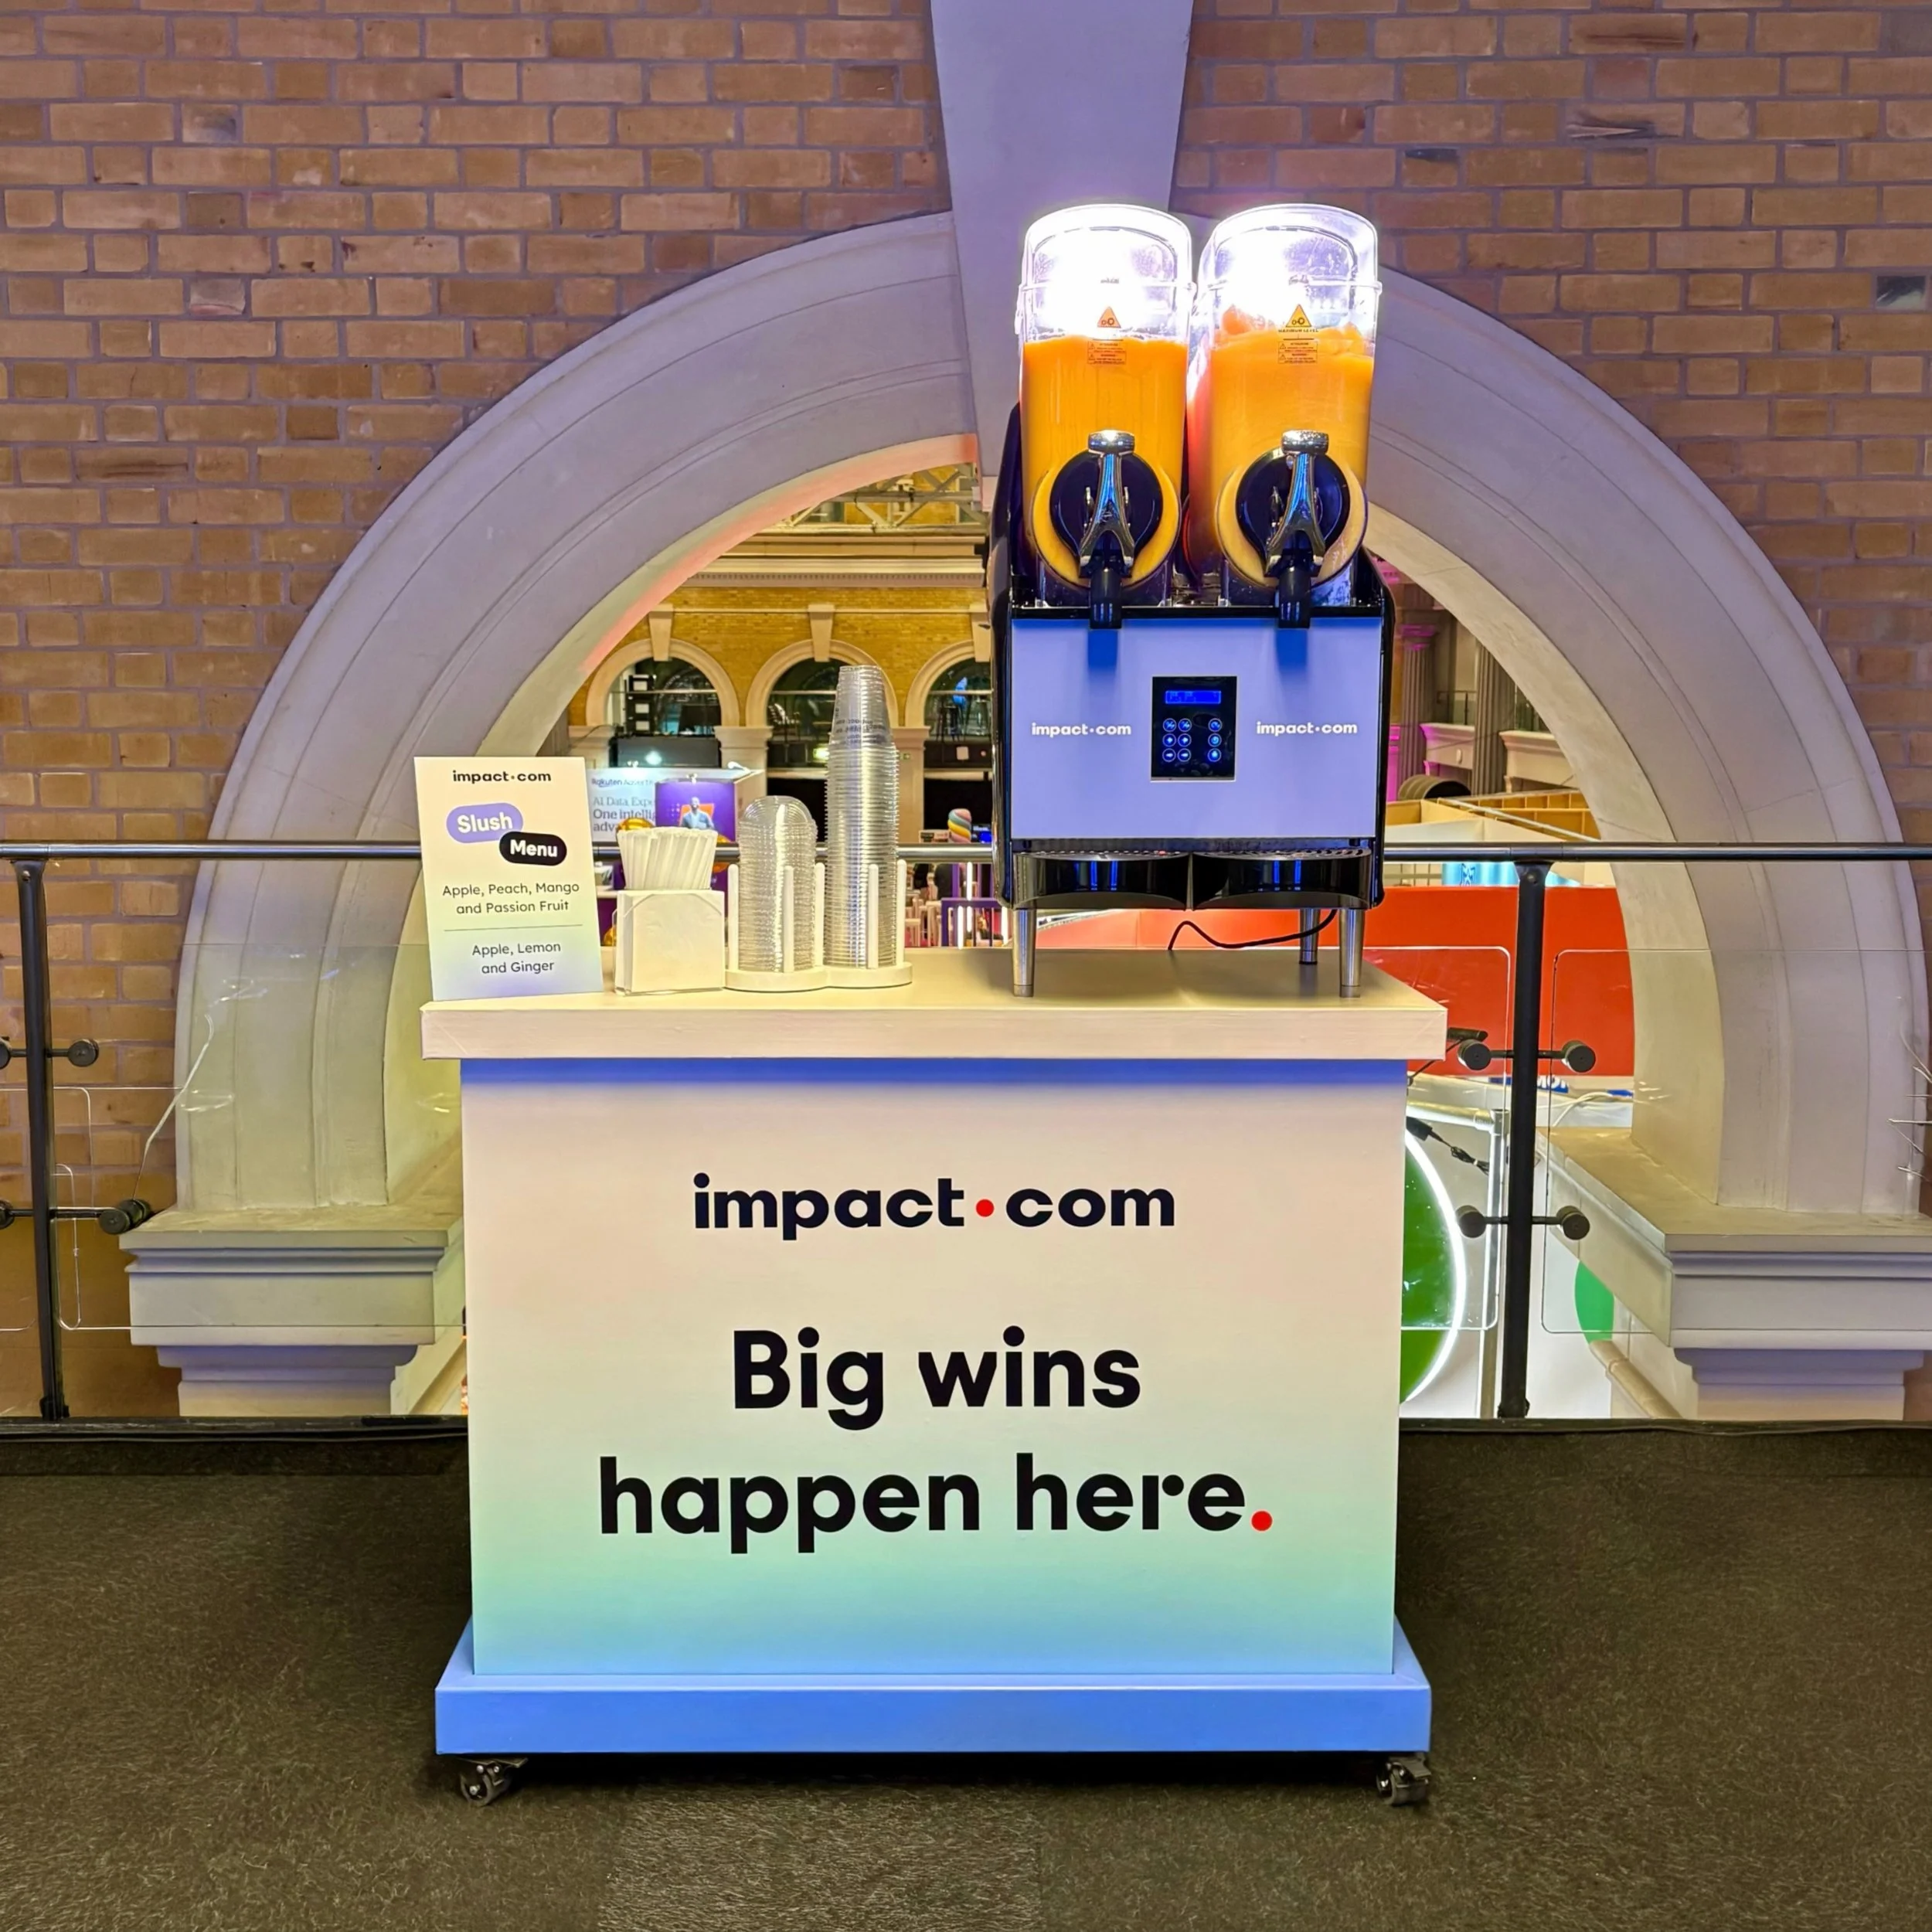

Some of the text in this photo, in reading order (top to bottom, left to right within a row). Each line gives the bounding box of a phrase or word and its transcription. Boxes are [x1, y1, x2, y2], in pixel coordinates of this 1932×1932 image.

[591, 778, 622, 787] Rakuten
[594, 797, 604, 806] AI
[607, 797, 629, 806] Data
[593, 808, 617, 819] One
[457, 811, 513, 834] Slush
[509, 838, 558, 858] Menu
[442, 883, 580, 898] Apple, Peach, Mango
[456, 900, 569, 914] and Passion Fruit
[472, 943, 561, 958] Apple, Lemon
[481, 961, 555, 975] and Ginger
[733, 1325, 1141, 1431] Big wins
[600, 1452, 1273, 1554] happen here.
